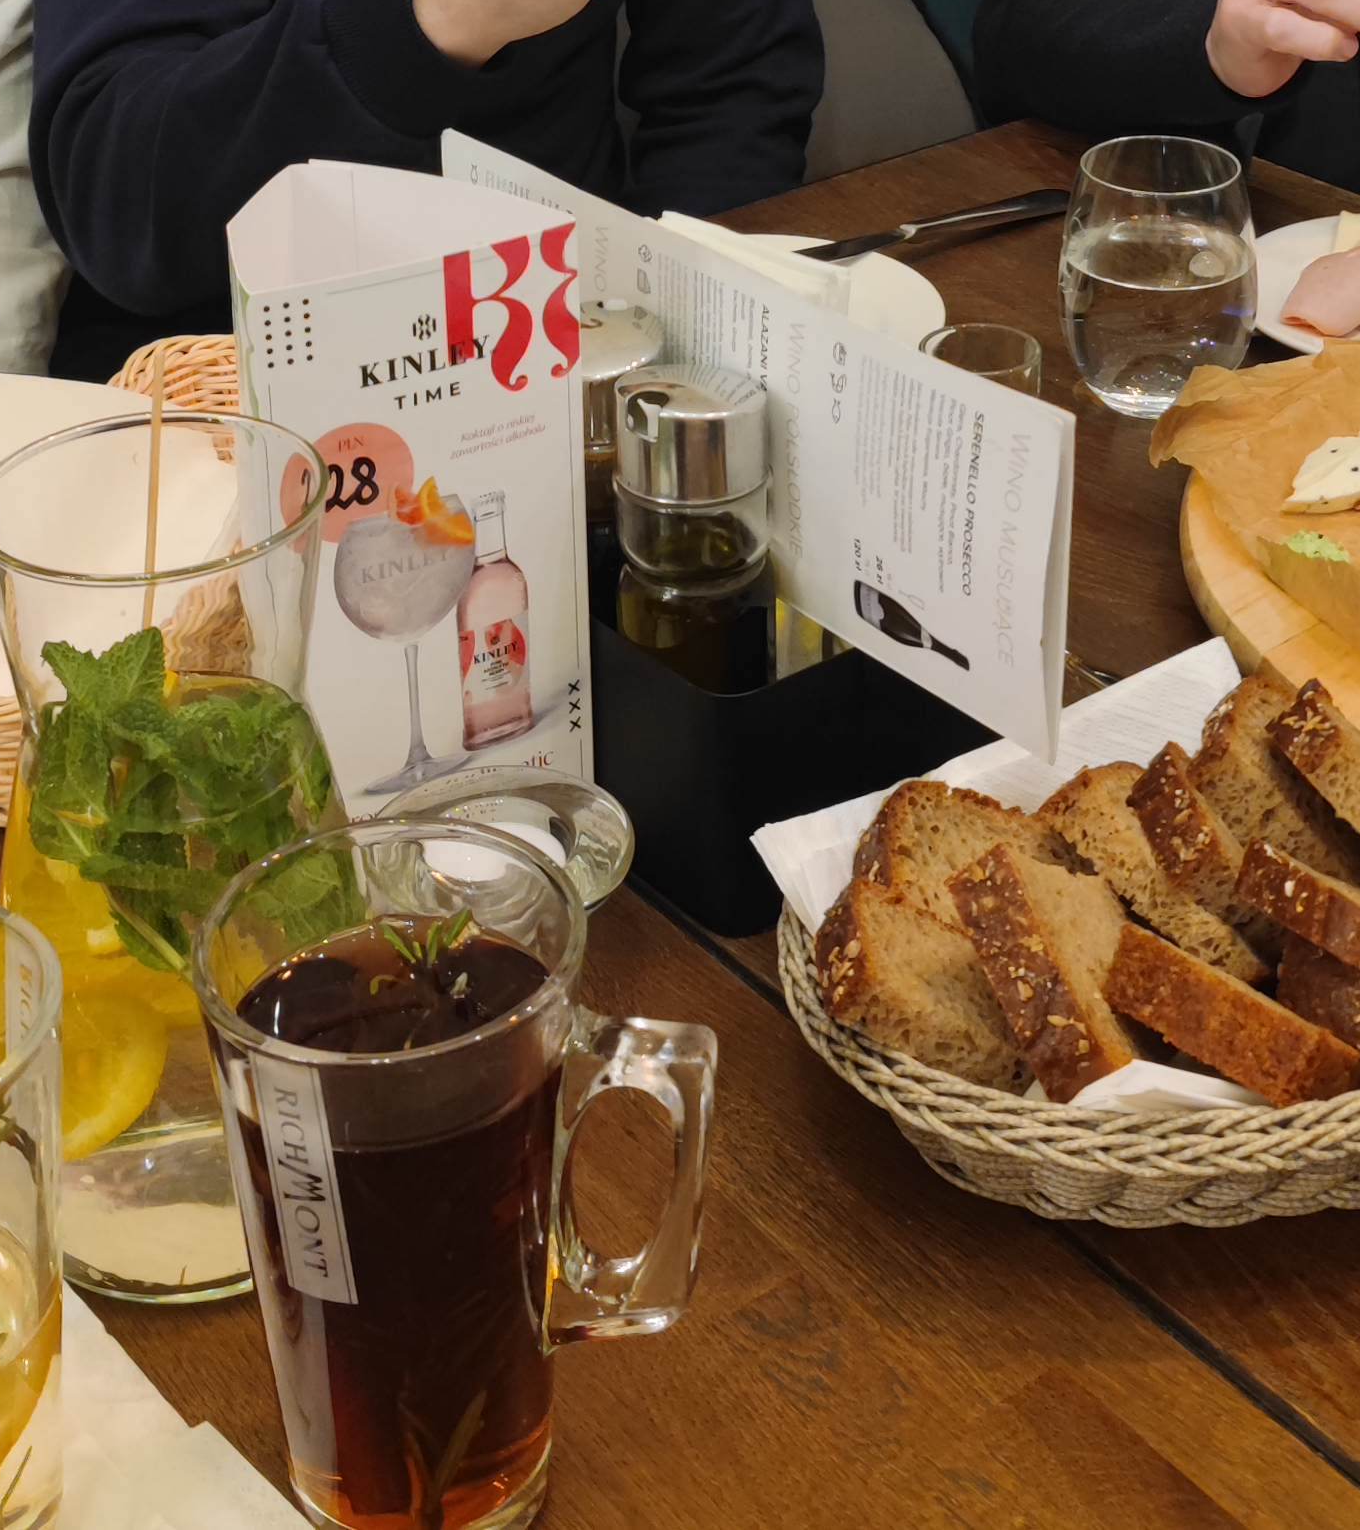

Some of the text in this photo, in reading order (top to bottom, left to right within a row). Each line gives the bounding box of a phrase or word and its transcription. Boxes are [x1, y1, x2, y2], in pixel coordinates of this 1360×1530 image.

[358, 335, 490, 389] KINLEY
[760, 303, 770, 371] ALAZANI
[786, 322, 806, 395] WINO
[394, 382, 461, 409] TIME
[961, 411, 985, 597] SERENELLO PROSECCO
[1003, 431, 1032, 513] WINO
[473, 640, 518, 665] KINLEY
[274, 1086, 330, 1278] RICHMONT
